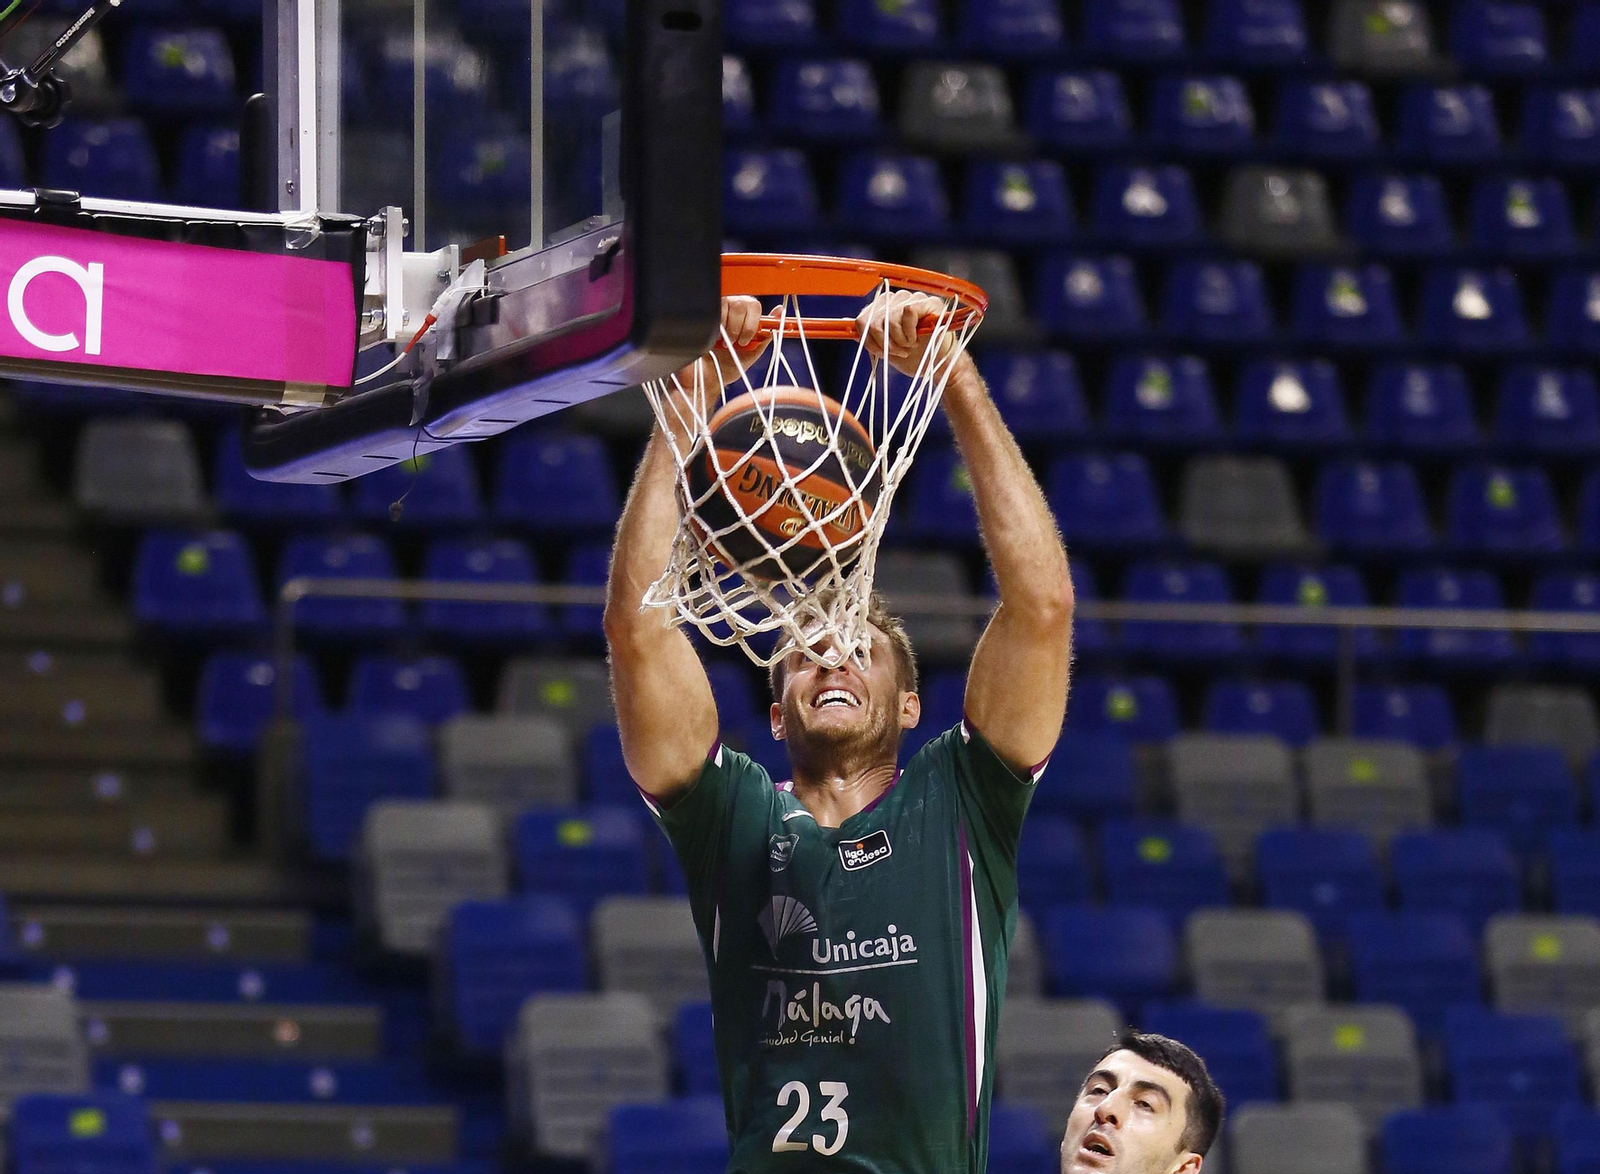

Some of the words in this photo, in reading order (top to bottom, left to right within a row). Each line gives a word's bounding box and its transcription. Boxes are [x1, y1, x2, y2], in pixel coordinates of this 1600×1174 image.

[7, 255, 104, 355] a
[844, 848, 864, 859] liga
[847, 845, 887, 866] endesa
[811, 924, 917, 964] Unicaja
[800, 1029, 844, 1047] Genial
[771, 1080, 850, 1156] 23
